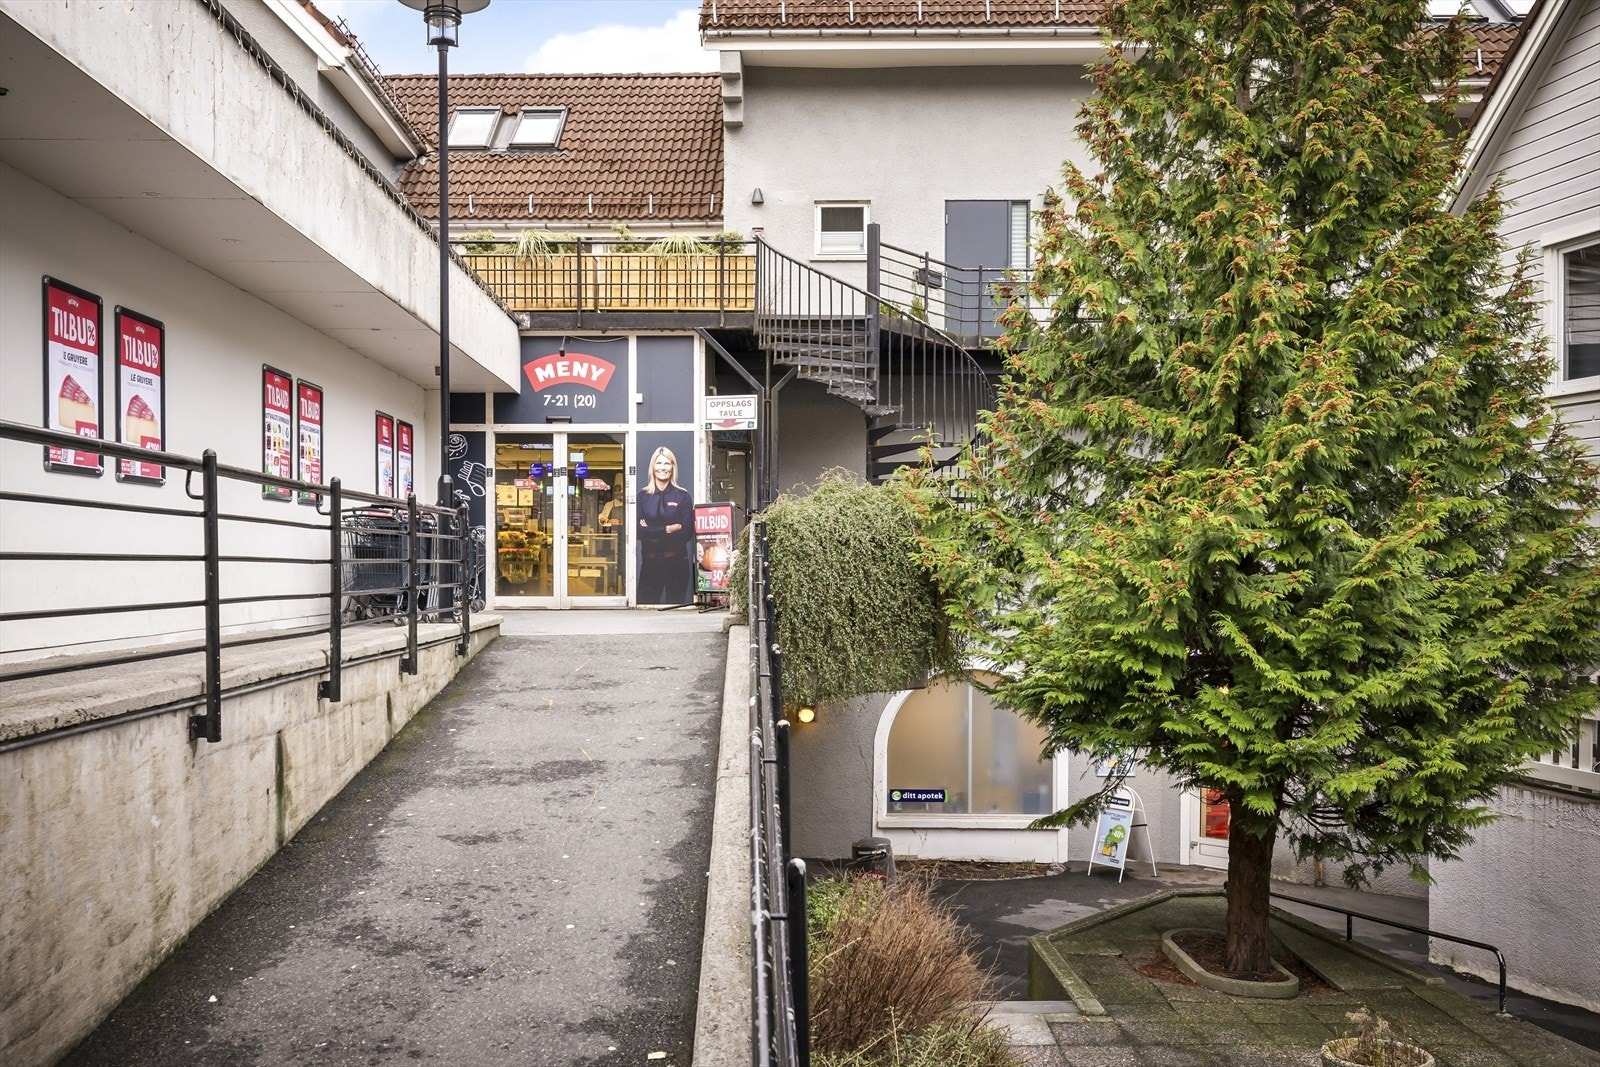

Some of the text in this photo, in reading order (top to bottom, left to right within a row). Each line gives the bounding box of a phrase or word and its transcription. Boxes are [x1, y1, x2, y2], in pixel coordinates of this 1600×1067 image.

[51, 306, 96, 347] TILBUD
[122, 333, 159, 369] TILBUD
[534, 361, 606, 383] MENY
[266, 383, 289, 410] TILBUD
[543, 394, 597, 409] 7-21 (20)
[709, 399, 752, 408] OPPSLAGS
[696, 515, 729, 531] TILBUD
[902, 791, 944, 801] ditt apotek
